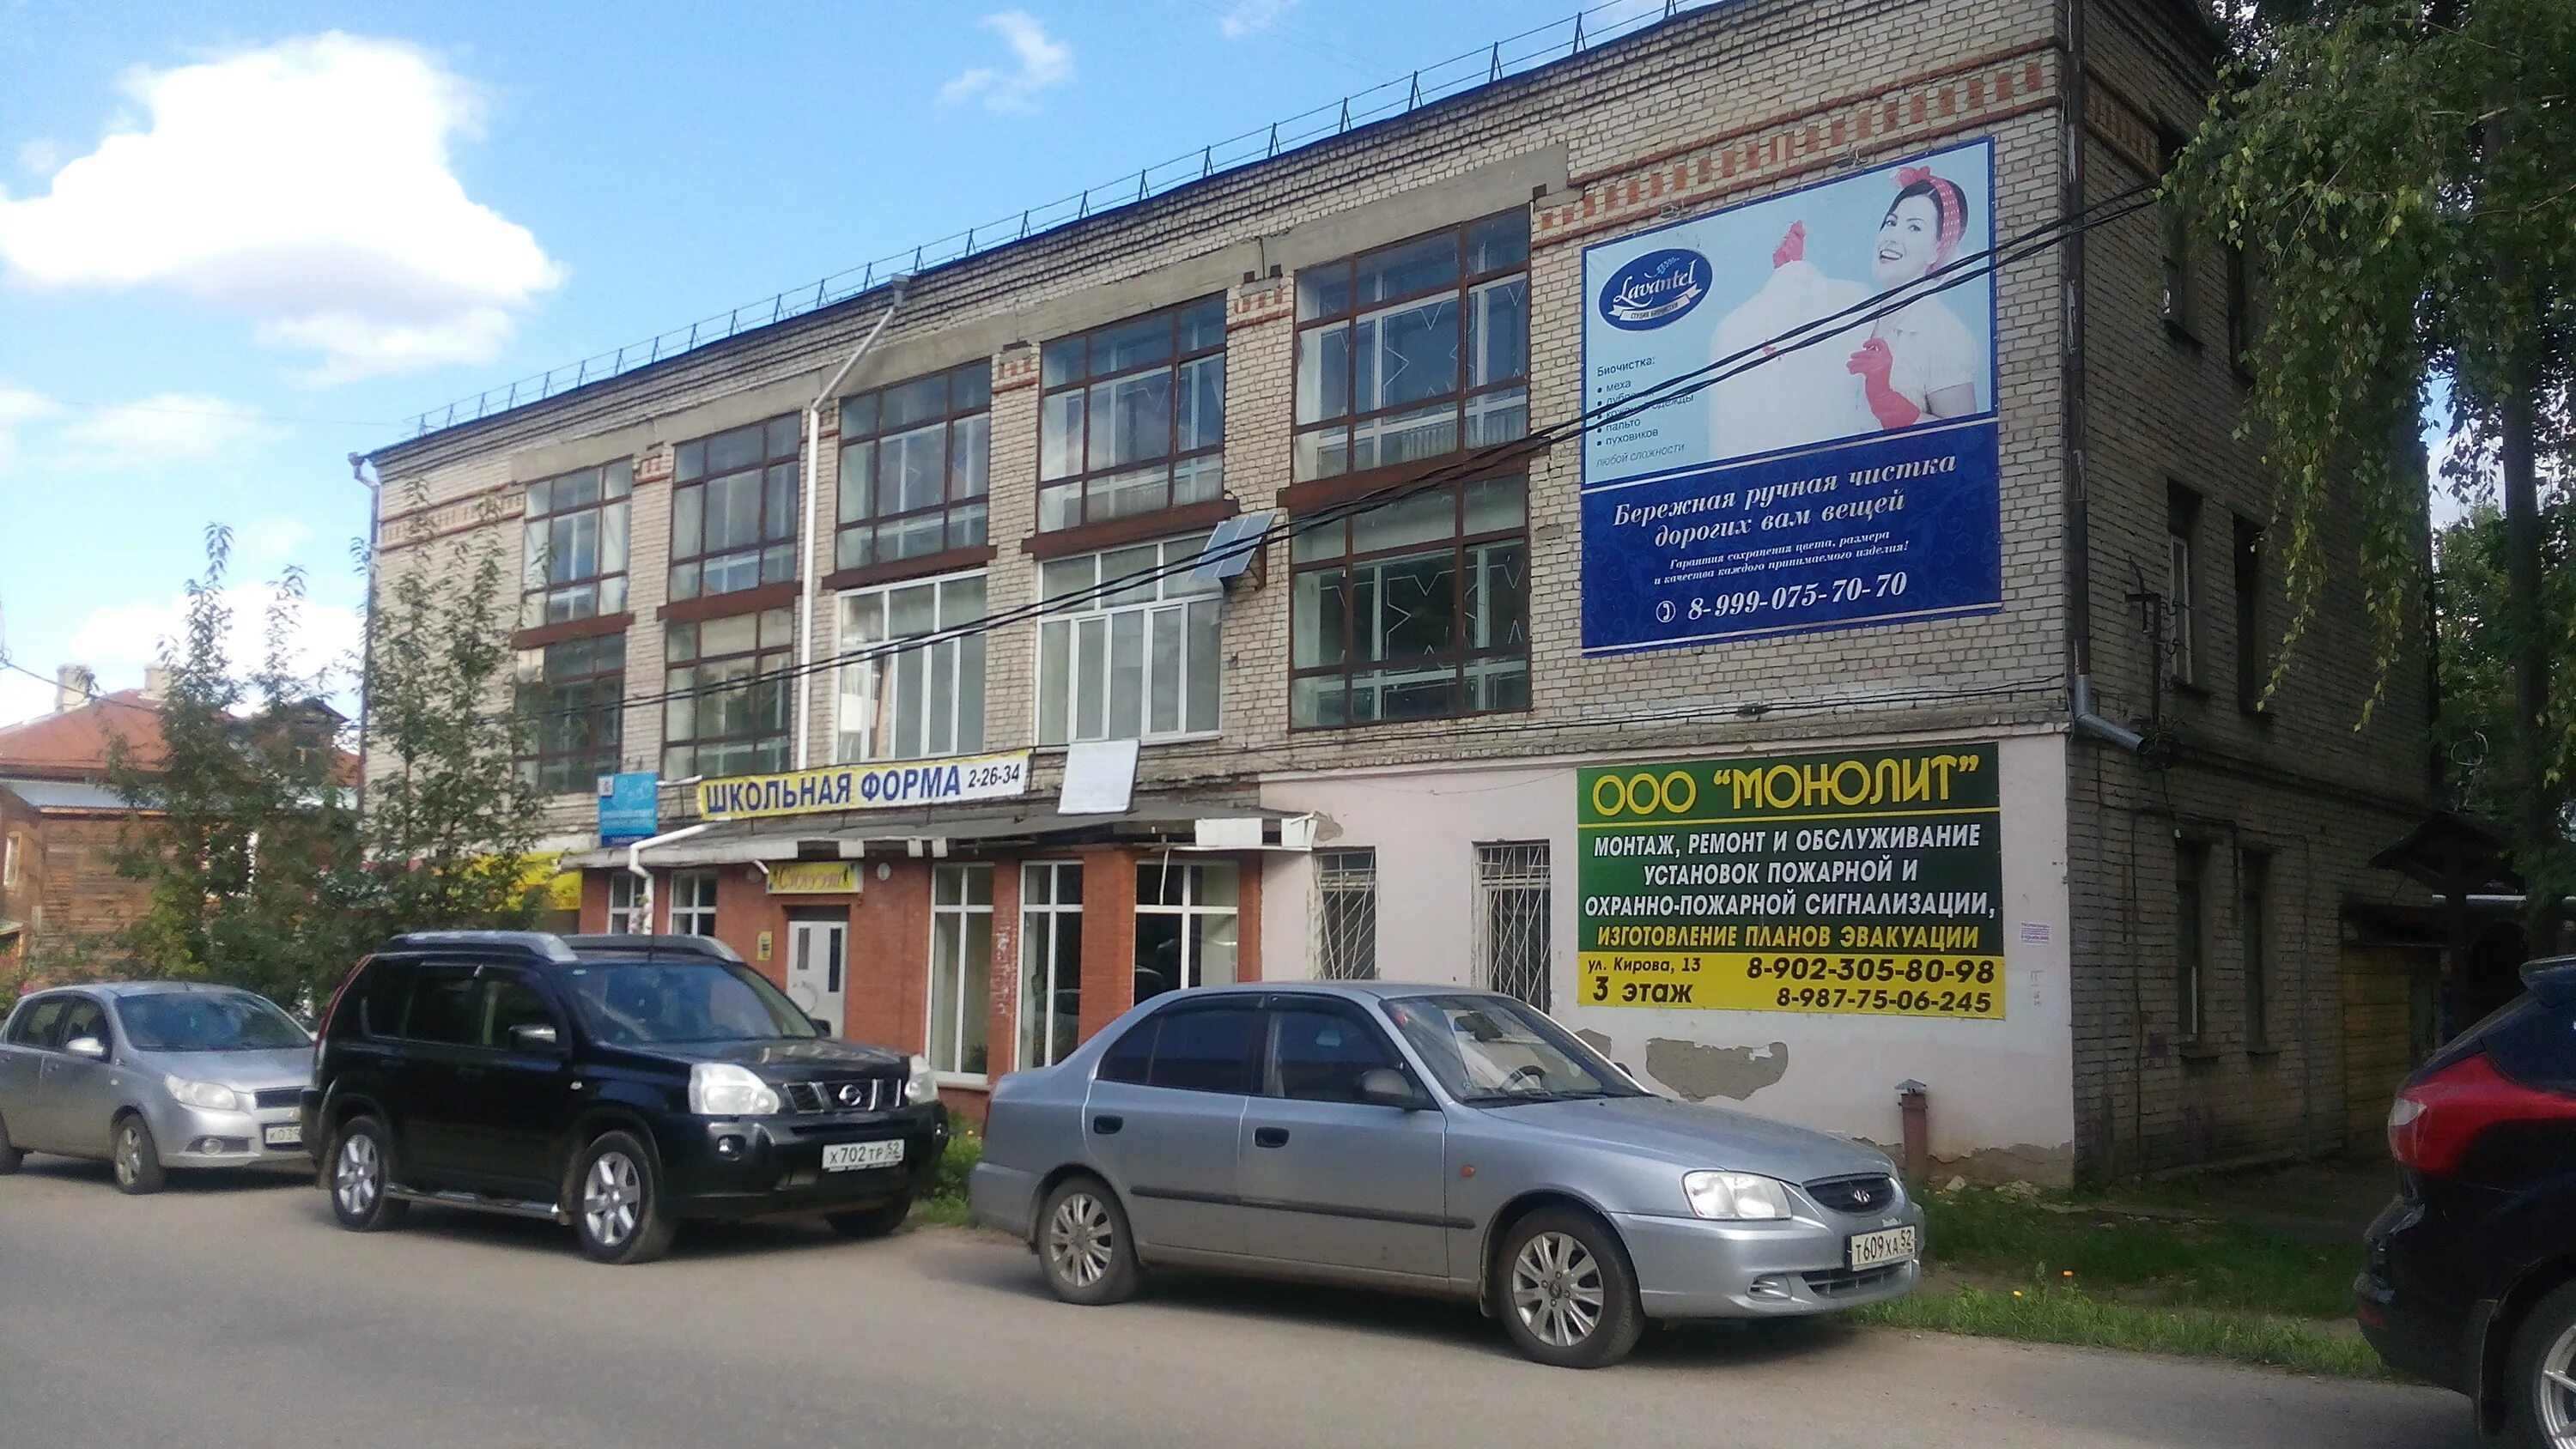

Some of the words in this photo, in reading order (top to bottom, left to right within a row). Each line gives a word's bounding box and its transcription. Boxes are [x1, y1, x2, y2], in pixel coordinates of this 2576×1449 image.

[1613, 258, 1698, 308] Lavantel
[1597, 356, 1656, 376] Биочистка:
[1606, 380, 1631, 392] меха
[1606, 418, 1641, 432] пальто
[1606, 429, 1659, 446] пуховиков
[1596, 452, 1628, 467] любой
[1630, 444, 1685, 461] сложности
[1613, 492, 1736, 527] Бережная
[1745, 475, 1838, 510] ручная
[1849, 455, 1957, 487] чистка
[1655, 518, 1752, 549] дорогих
[1761, 509, 1812, 531] вам
[1821, 488, 1905, 522] вещей
[1664, 570, 1715, 584] качества
[1717, 562, 1765, 576] каждого
[1768, 550, 1852, 571] принимаемого
[1856, 541, 1910, 558] изделия!
[1669, 555, 1724, 570] Гарантия
[1727, 544, 1792, 561] сохранения
[1795, 539, 1836, 554] цвета,
[1839, 530, 1890, 547] размера
[1687, 572, 1908, 620] 8-999-075-70-70
[705, 772, 852, 814] ШКОЛЬНАЯ
[860, 765, 962, 802] ФОРМА
[968, 762, 1021, 788] 2-26-34
[1592, 771, 1697, 816] ООО
[1594, 834, 1680, 858] МОНТАЖ,
[1688, 831, 1765, 854] РЕМОНТ
[1773, 831, 1788, 853] И
[1795, 824, 1981, 851] ОБСЛУЖИВАНИЕ
[1643, 863, 1760, 885] УСТАНОВОК
[1767, 854, 1893, 884] ПОЖАРНОЙ
[1902, 859, 1917, 882] И
[1584, 888, 1795, 916] ОХРАННО-ПОЖАРНОЙ
[1805, 892, 1996, 919] СИГНАЛИЗАЦИИ,
[1597, 925, 1737, 947] ИЗГОТОВЛЕНИЕ
[1745, 925, 1831, 948] ПЛАНОВ
[1839, 925, 1978, 952] ЭВАКУАЦИИ
[1588, 959, 1607, 973] ул.
[1613, 957, 1675, 974] Кирова,
[1681, 957, 1701, 972] 13
[1747, 956, 1995, 984] 8-902-305-80-98
[1593, 976, 1609, 1002] 3
[1621, 982, 1693, 1003] этаж
[1777, 987, 1991, 1013] 8-987-75-06-245
